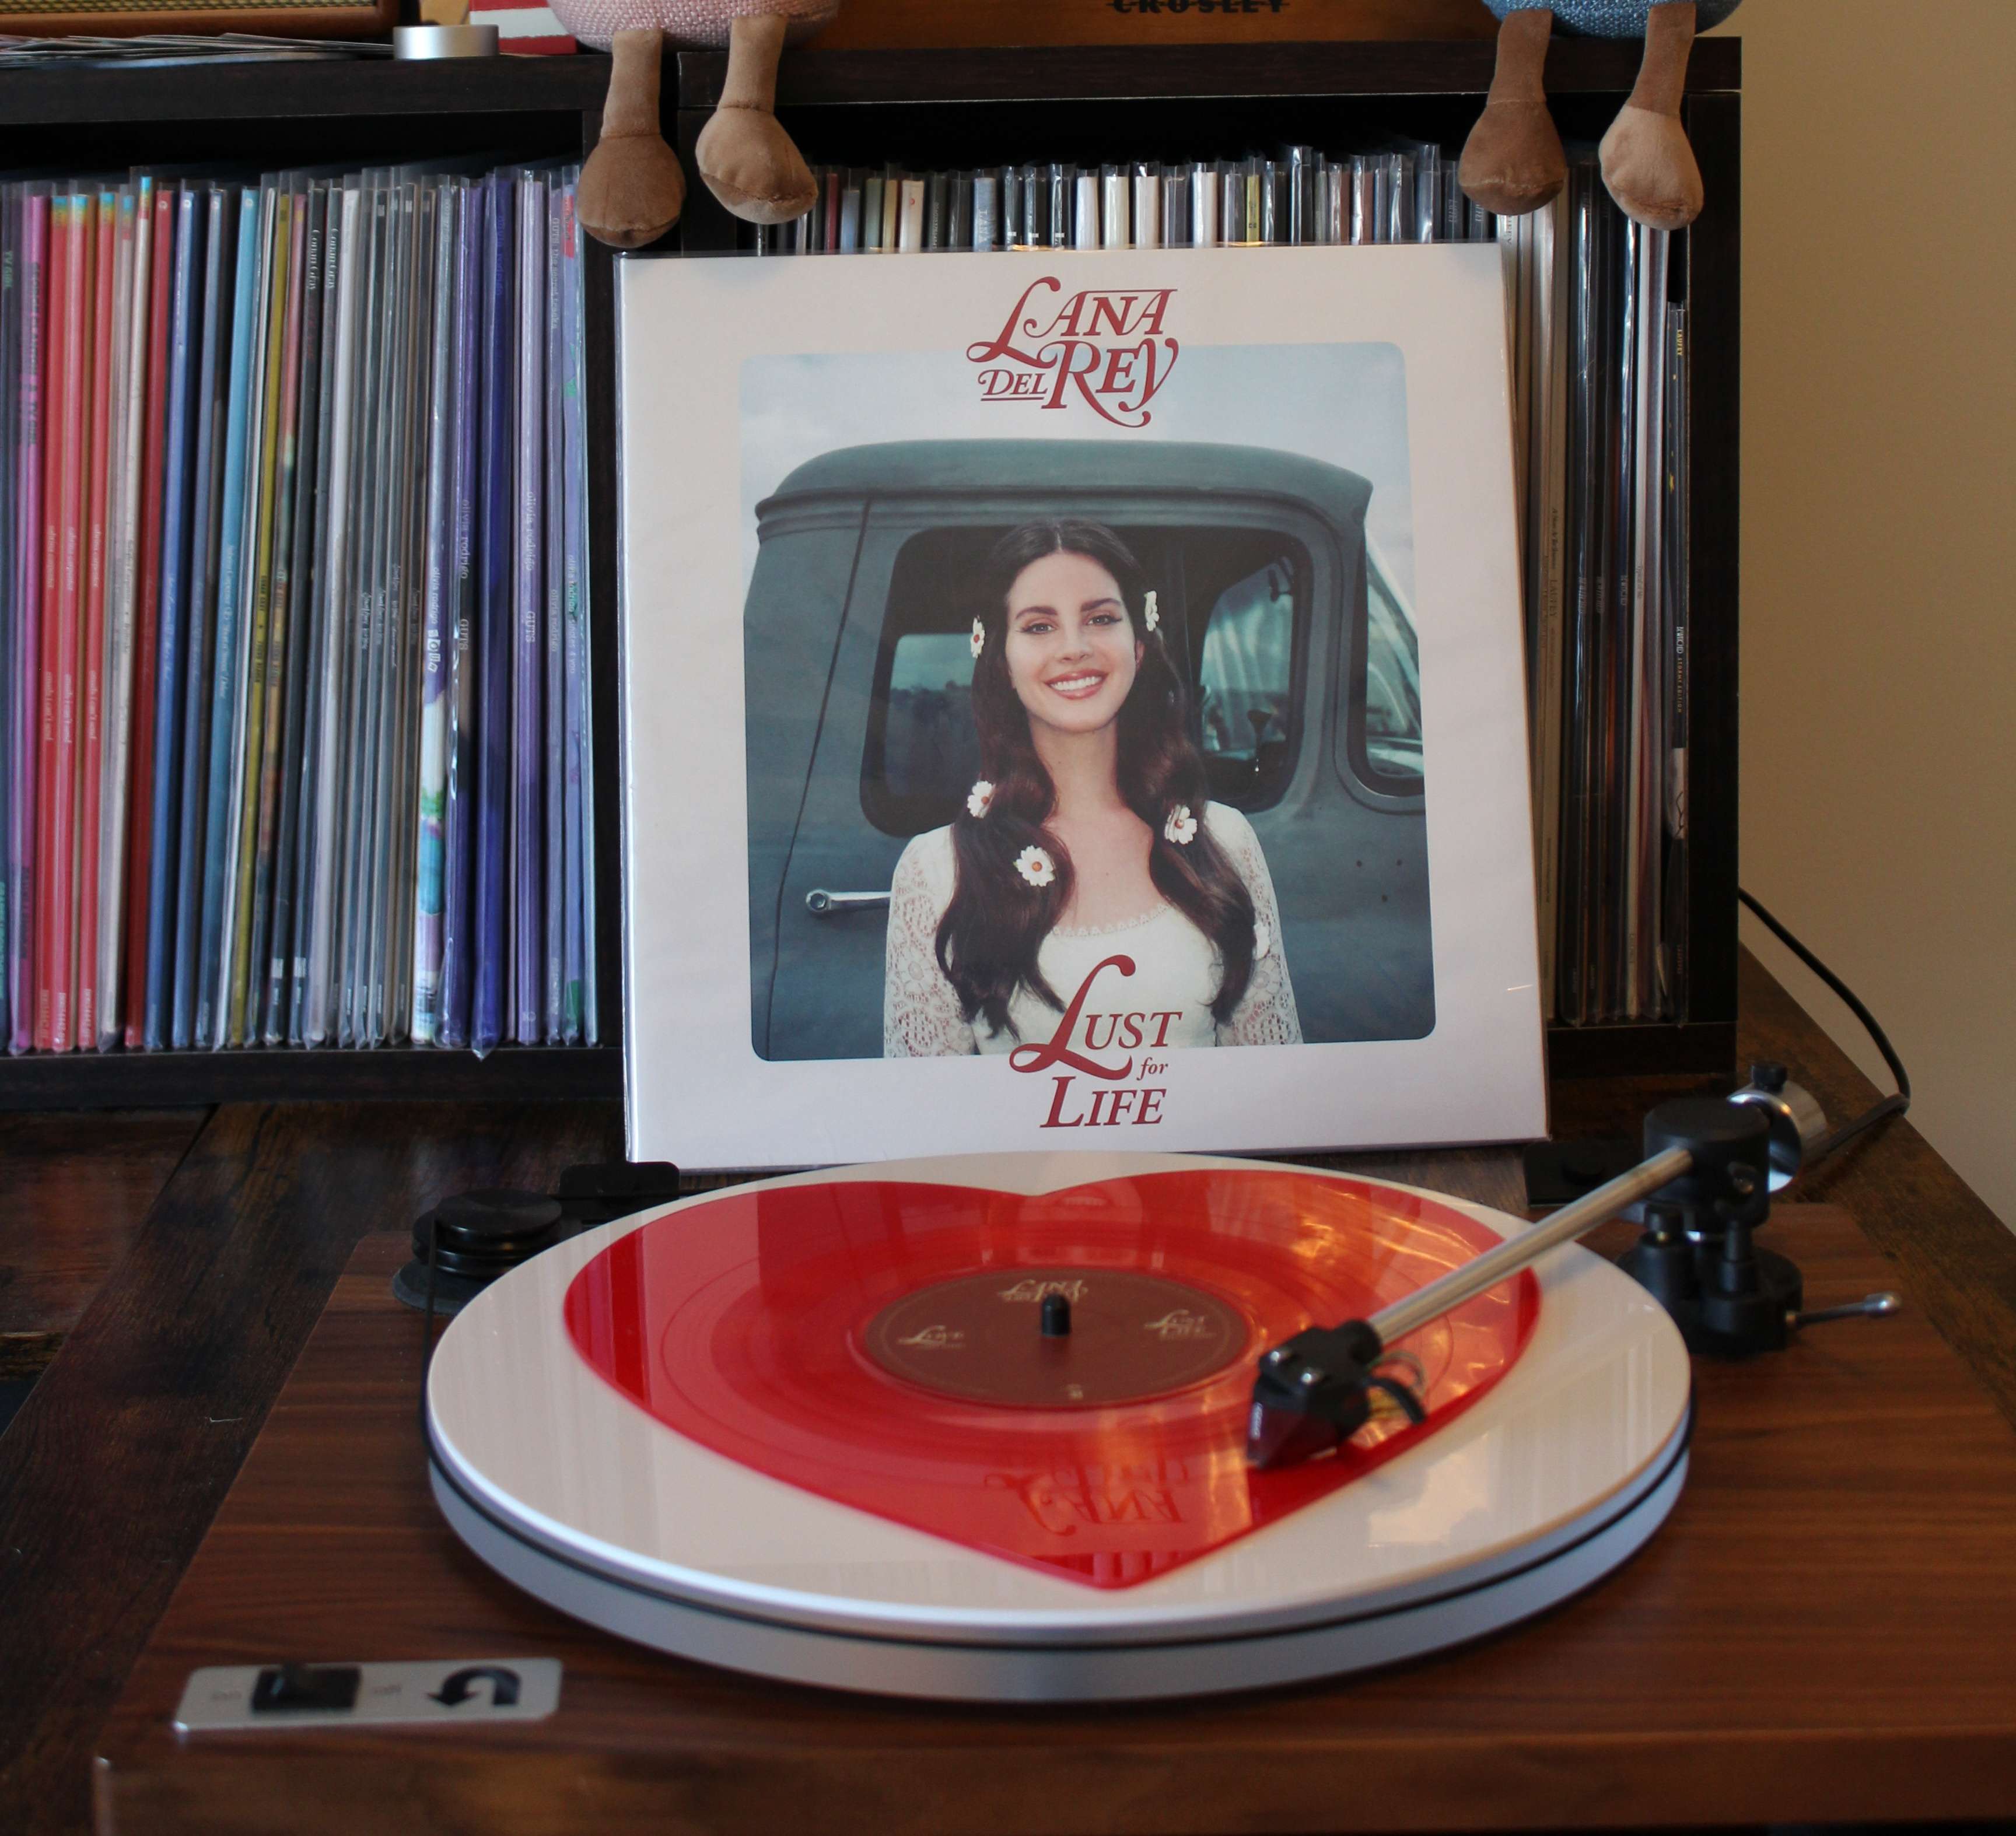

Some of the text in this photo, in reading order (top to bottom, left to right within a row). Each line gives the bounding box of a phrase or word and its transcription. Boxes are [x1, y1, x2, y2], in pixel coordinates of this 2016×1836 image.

[310, 230, 320, 263] Conan
[328, 228, 338, 262] Conan
[307, 266, 318, 289] Gray
[326, 265, 337, 289] Gray
[966, 276, 1178, 369] LANA
[978, 337, 1179, 428] DEL REY
[431, 567, 440, 590] olivia
[459, 499, 470, 650] olivia rodrigo GUTS
[524, 491, 535, 642] olivia rodrigo GUTS
[568, 555, 576, 577] olivia
[430, 592, 439, 623] rodrigo
[550, 588, 558, 615] olivia
[1009, 955, 1183, 1080] LUST
[1136, 1057, 1168, 1081] for
[1040, 1076, 1167, 1128] LIFE
